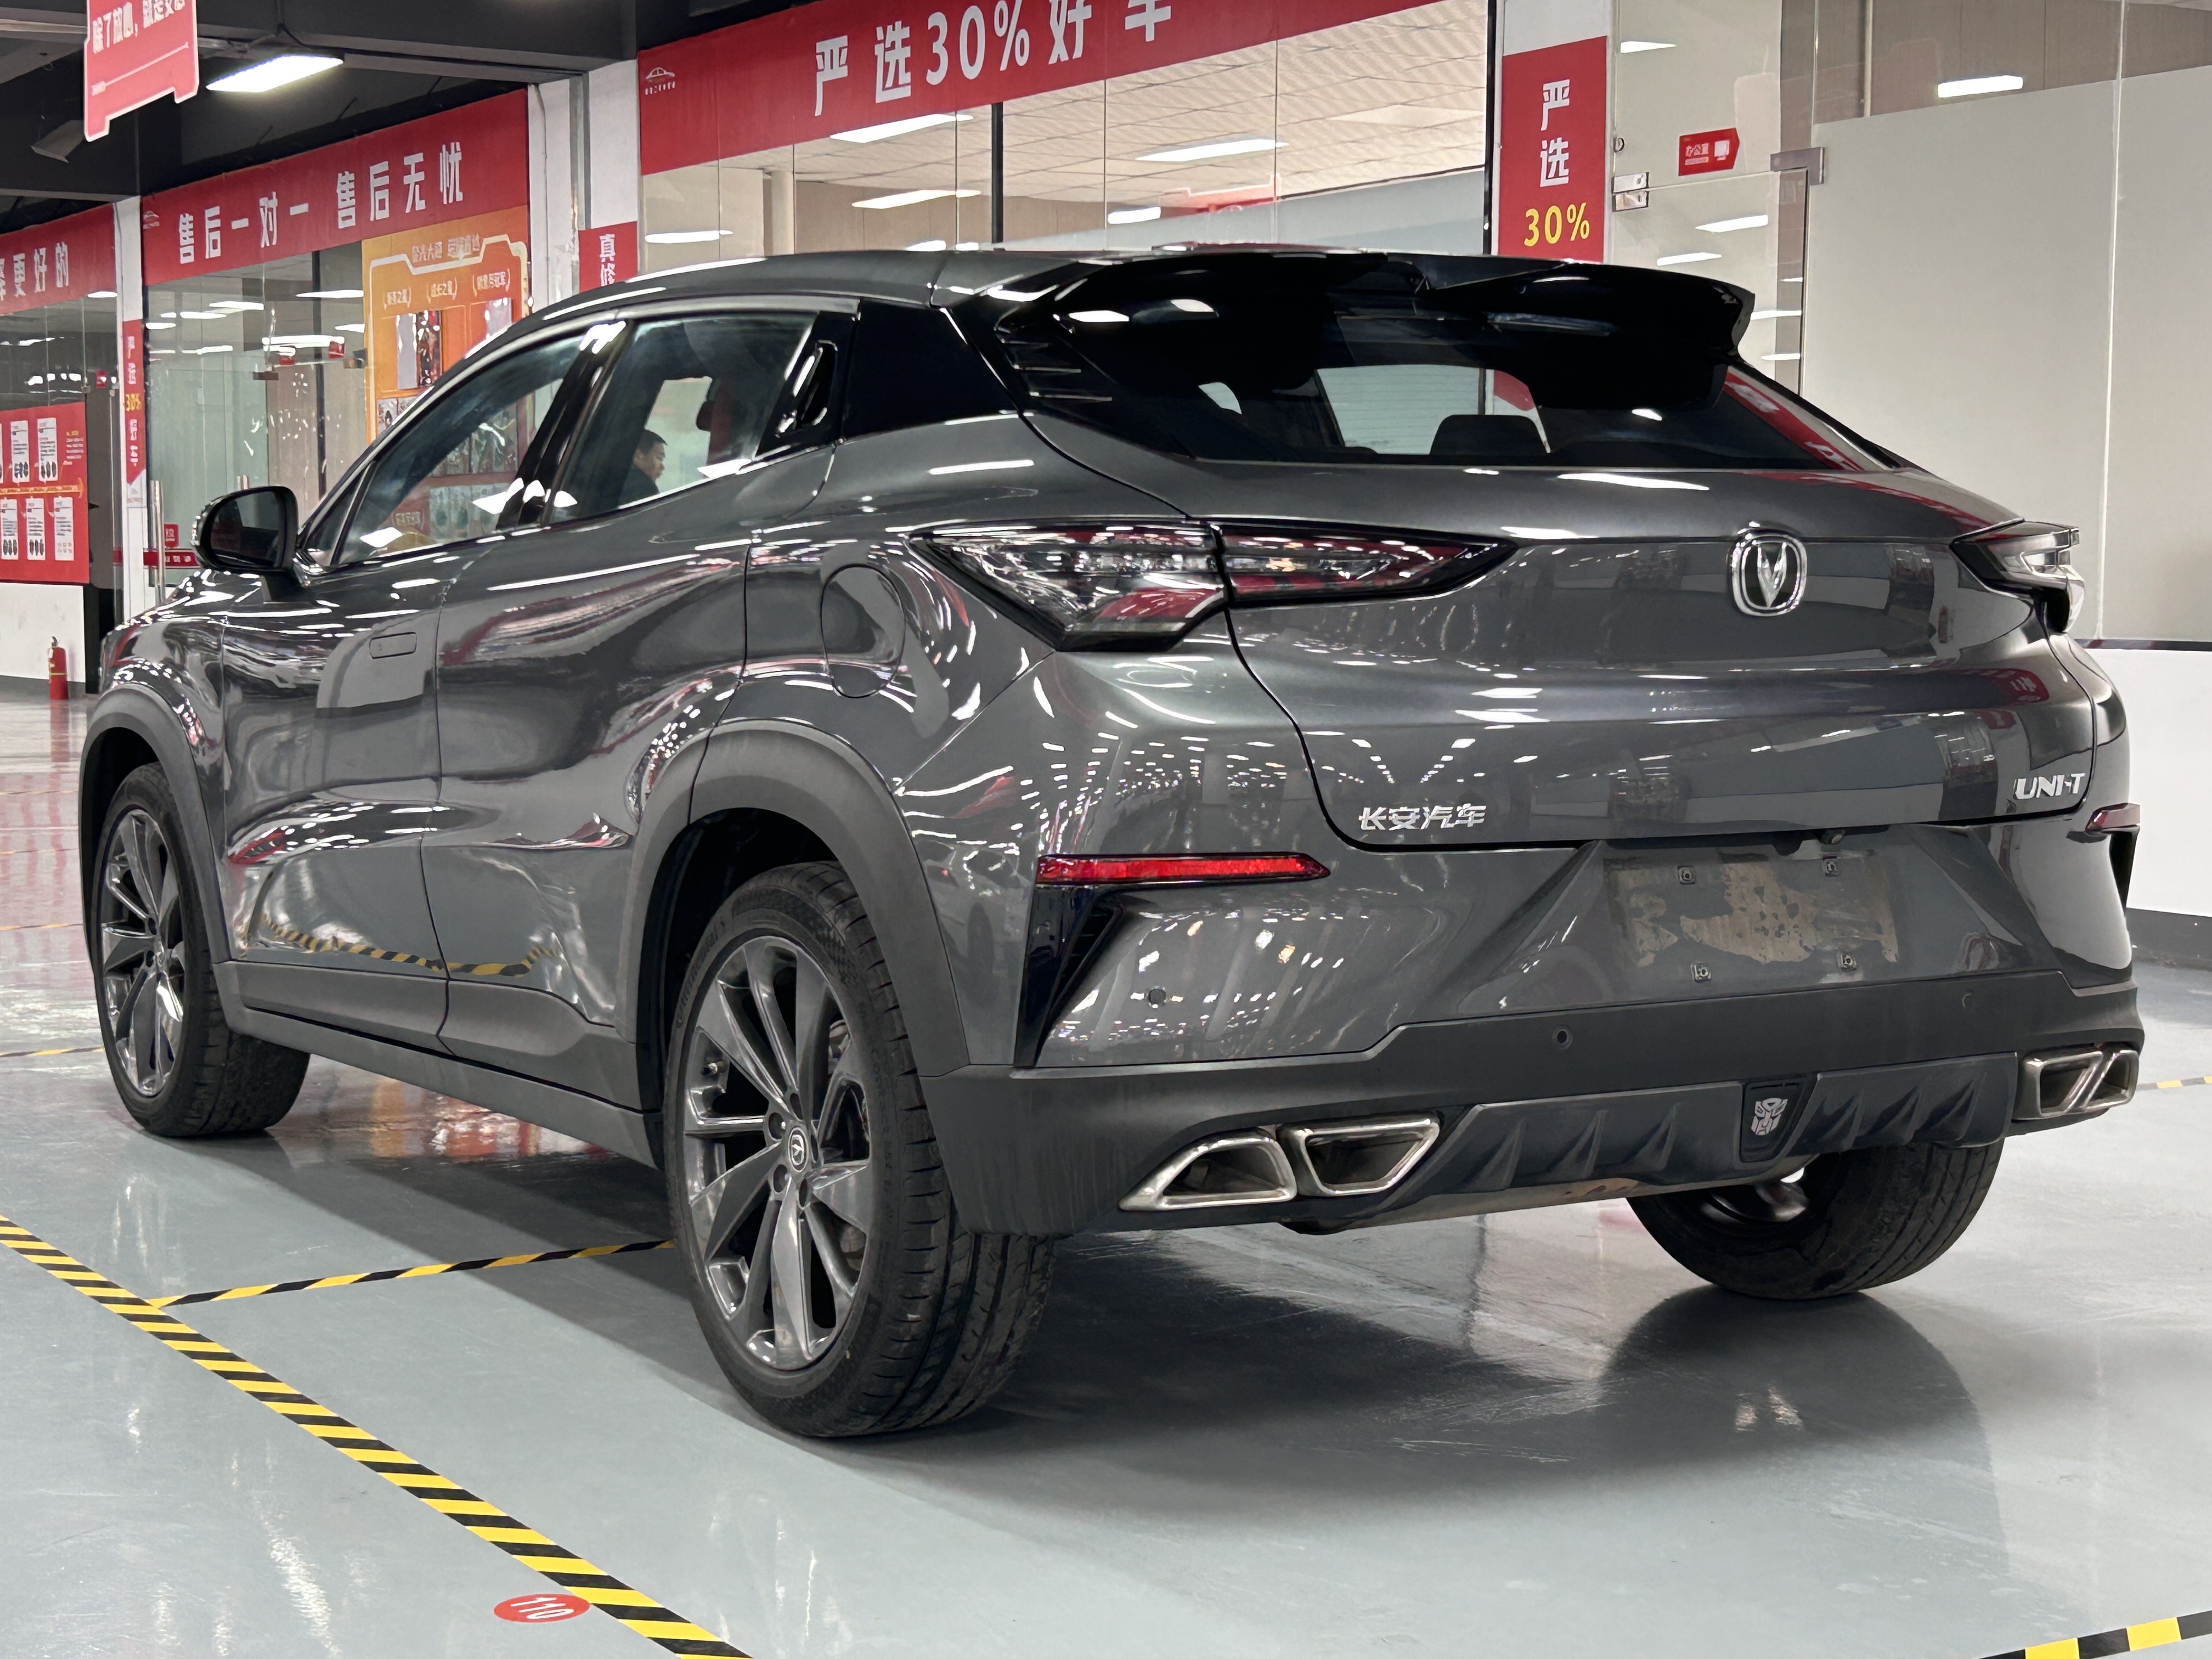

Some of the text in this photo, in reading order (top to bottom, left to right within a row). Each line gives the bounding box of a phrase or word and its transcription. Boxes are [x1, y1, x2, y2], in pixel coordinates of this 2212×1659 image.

[1541, 79, 1570, 187] 严选
[179, 142, 464, 264] 售后一对一 售后无忧
[1523, 202, 1590, 247] 30%
[1358, 803, 1487, 831] 长安汽车
[510, 1596, 574, 1619] 110
